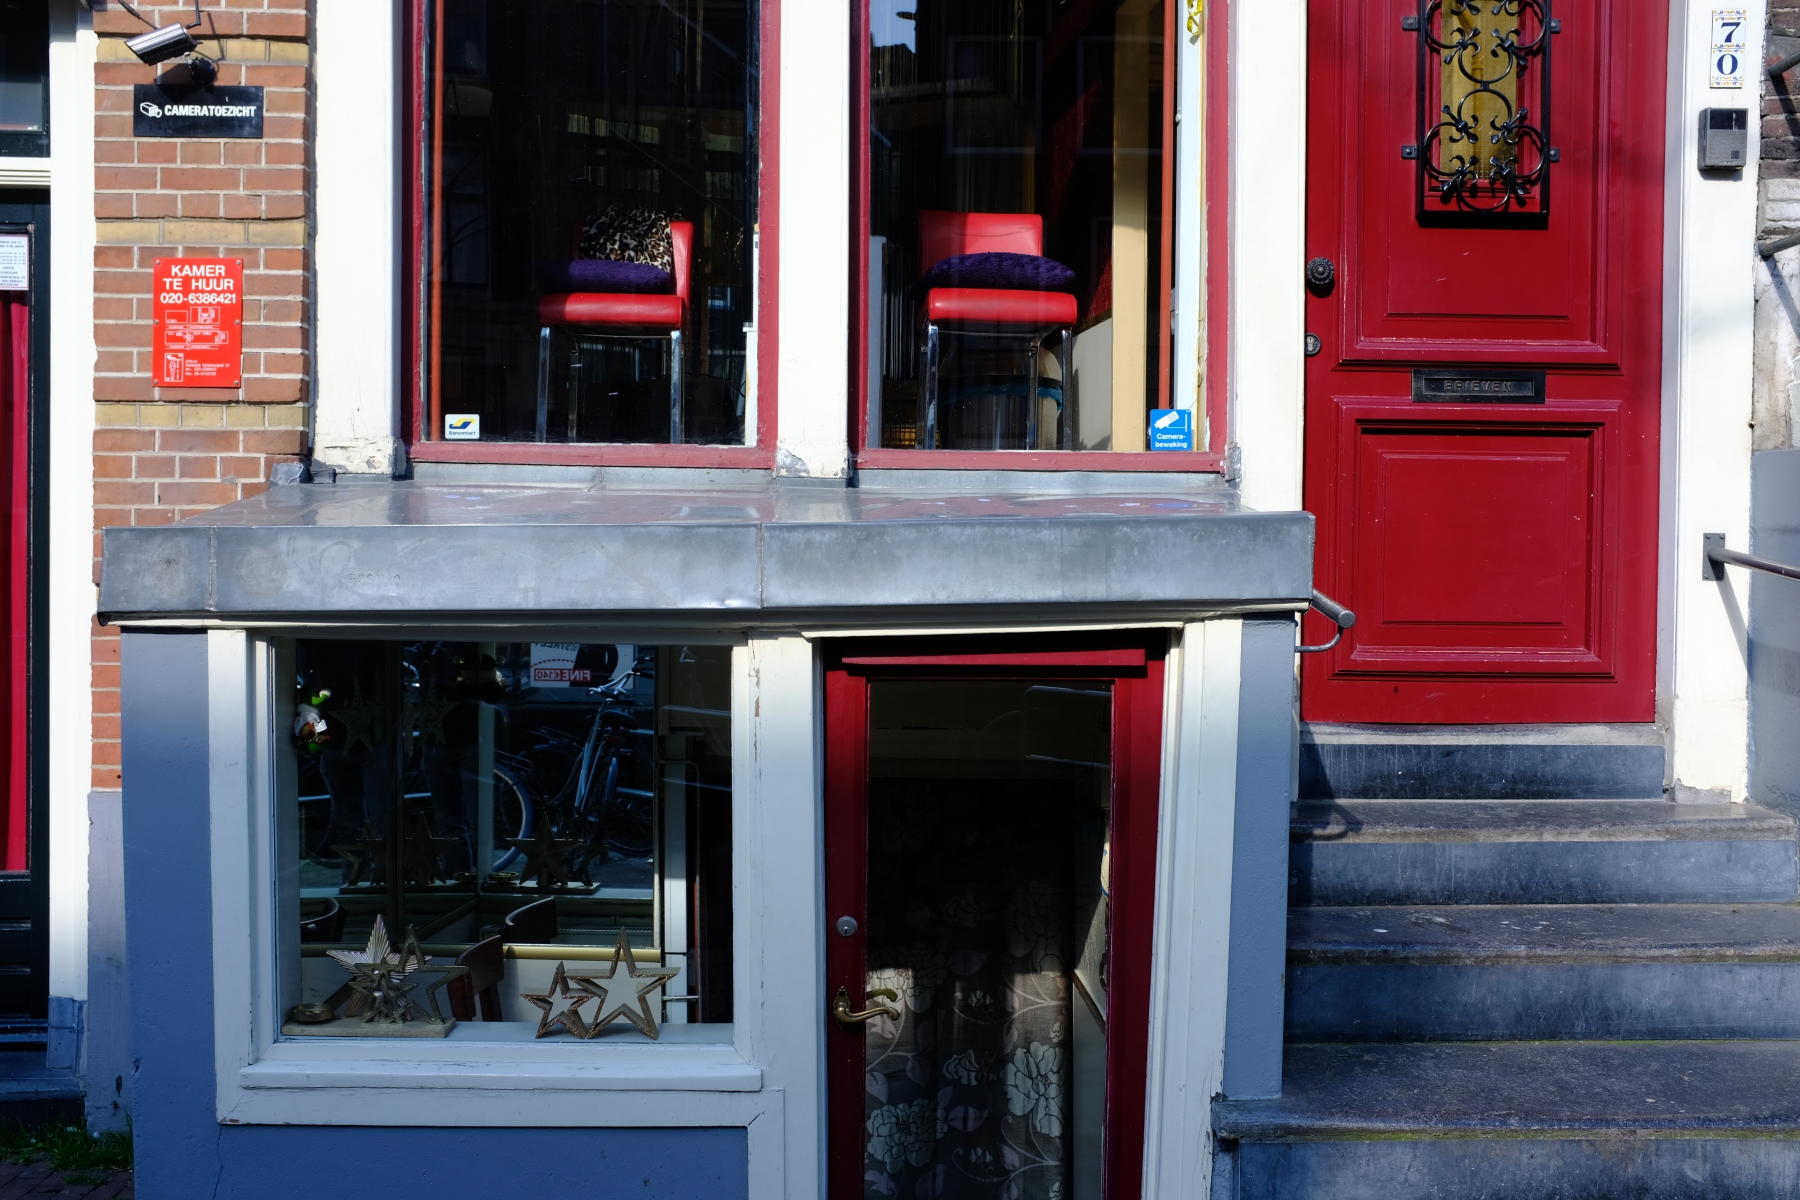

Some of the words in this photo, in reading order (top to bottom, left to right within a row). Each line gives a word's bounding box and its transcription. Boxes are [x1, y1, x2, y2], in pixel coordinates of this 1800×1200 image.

[164, 104, 257, 117] CAMERATOEZICHT
[171, 264, 226, 277] KAMER
[163, 278, 183, 291] TE
[192, 278, 234, 291] HUUR
[160, 293, 236, 304] 020-6386421
[1444, 380, 1511, 392] BRIEVEN
[1155, 441, 1188, 449] bewaking
